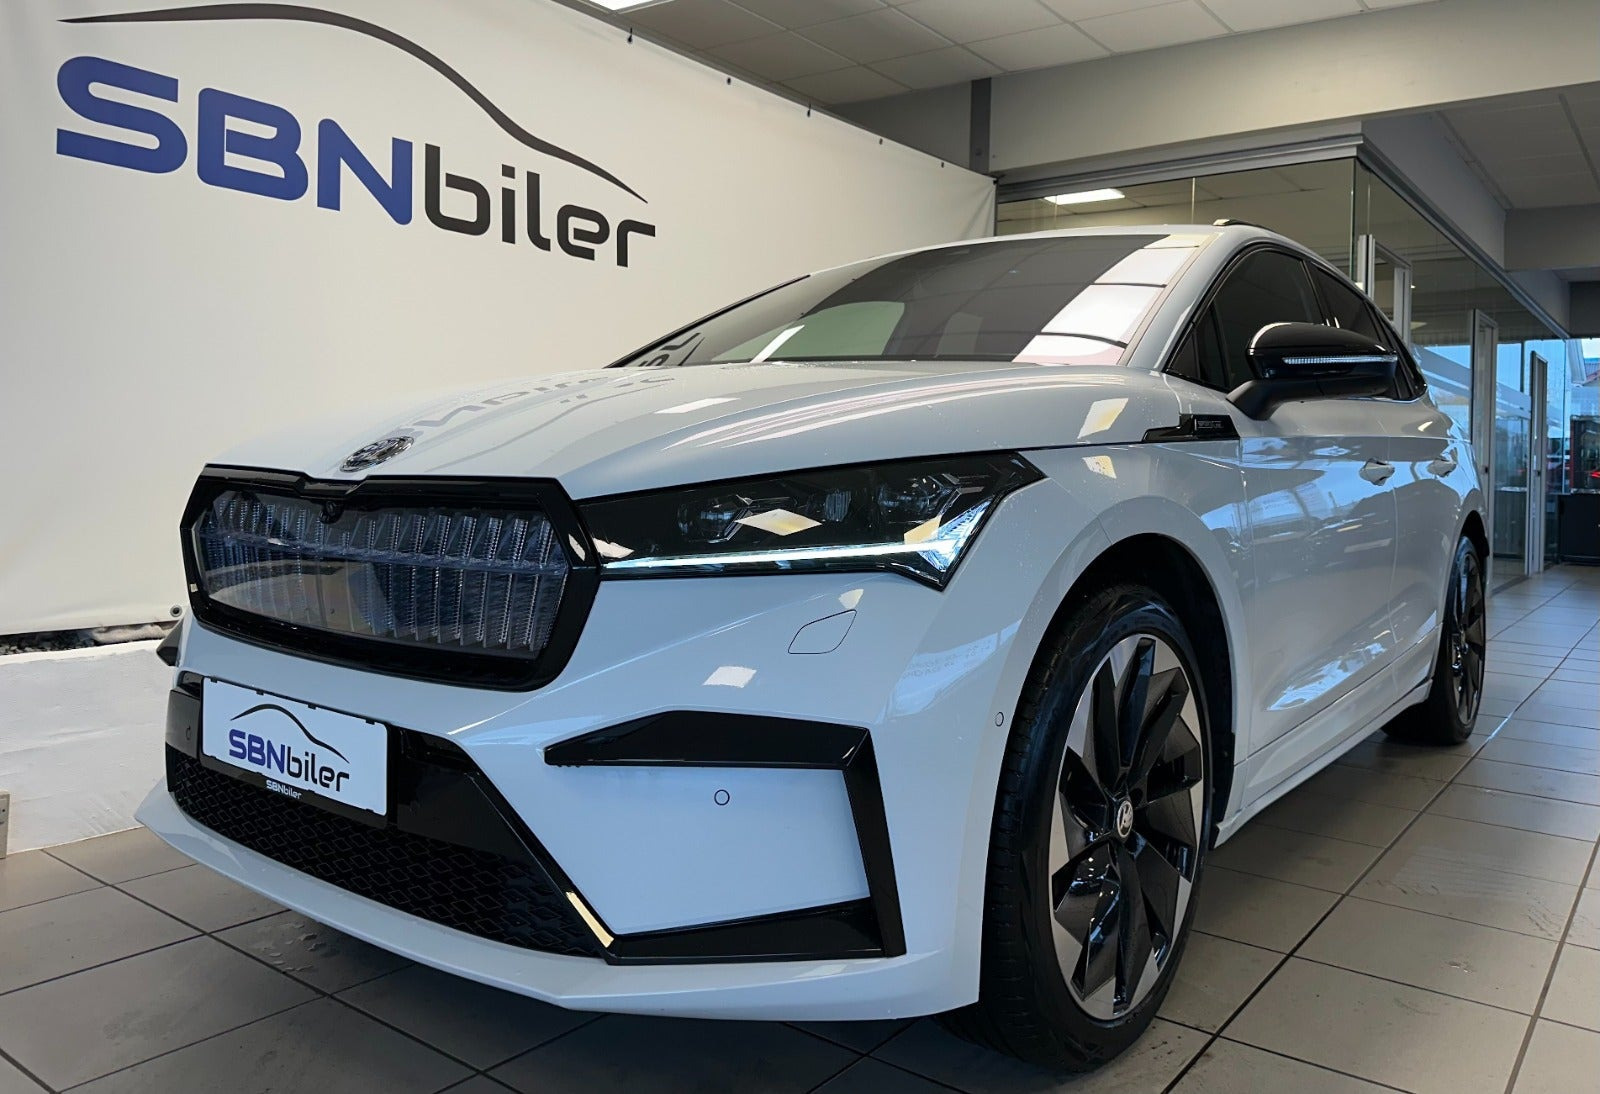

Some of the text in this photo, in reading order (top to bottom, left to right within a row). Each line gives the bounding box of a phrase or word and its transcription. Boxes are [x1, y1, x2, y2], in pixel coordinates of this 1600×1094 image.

[57, 56, 656, 268] SBNbiler
[229, 729, 350, 792] SBNbiler
[265, 779, 302, 799] SBNbiler
